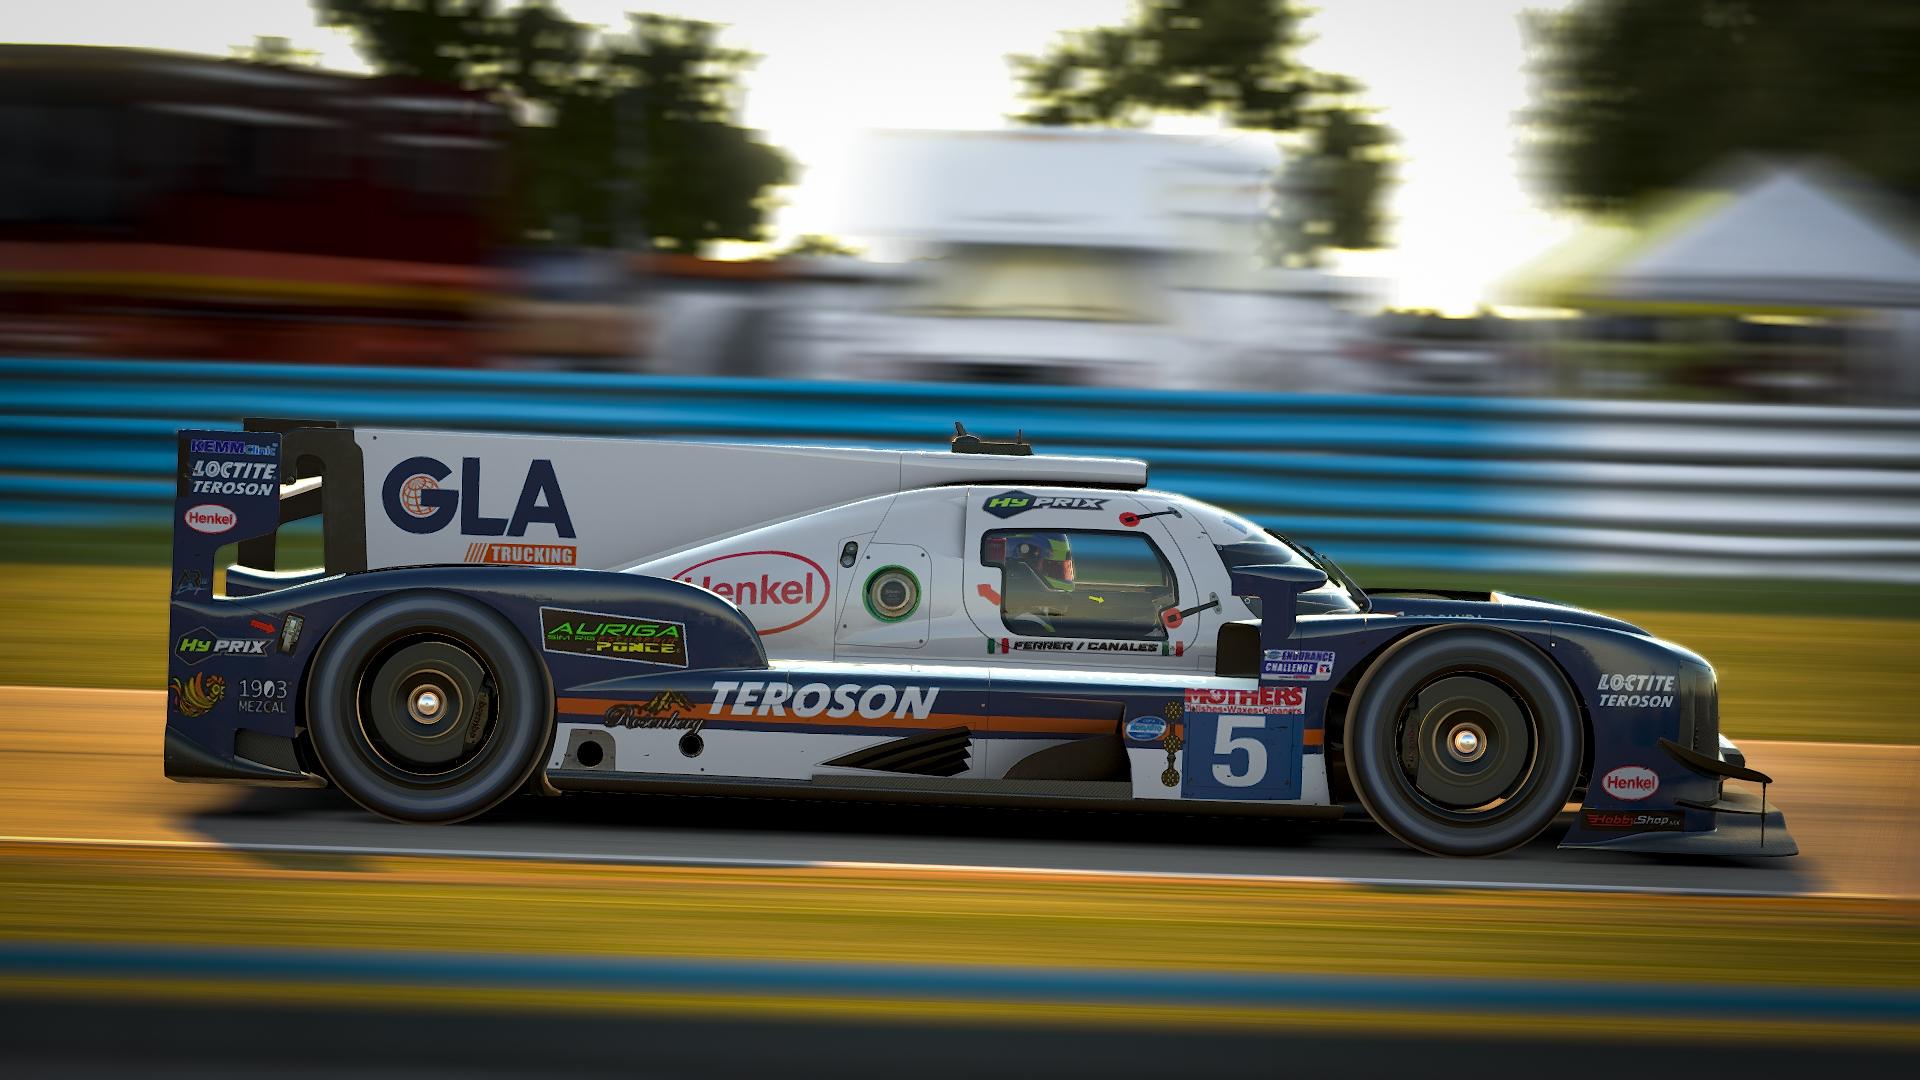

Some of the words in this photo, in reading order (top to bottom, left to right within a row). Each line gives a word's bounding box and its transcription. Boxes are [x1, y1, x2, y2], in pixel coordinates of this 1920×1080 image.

[192, 460, 277, 480] LOCTITE
[193, 481, 274, 496] TEROSON
[382, 456, 577, 539] GLA
[188, 512, 234, 526] Henkel
[491, 545, 573, 563] TRUCKING
[684, 573, 813, 605] enkel
[548, 622, 680, 638] AURIGA
[1014, 640, 1073, 651] FERRER
[1087, 642, 1158, 652] CANALES
[1265, 662, 1313, 673] CHALLENGE
[239, 680, 287, 699] 1903
[1597, 673, 1675, 692] LOCTITE
[709, 681, 940, 720] TEROSON
[1184, 687, 1304, 706] MOTHERS
[1599, 694, 1673, 708] TEROSON
[239, 701, 286, 713] MEZCAL
[1211, 715, 1268, 787] 5
[1607, 776, 1655, 791] Henkel
